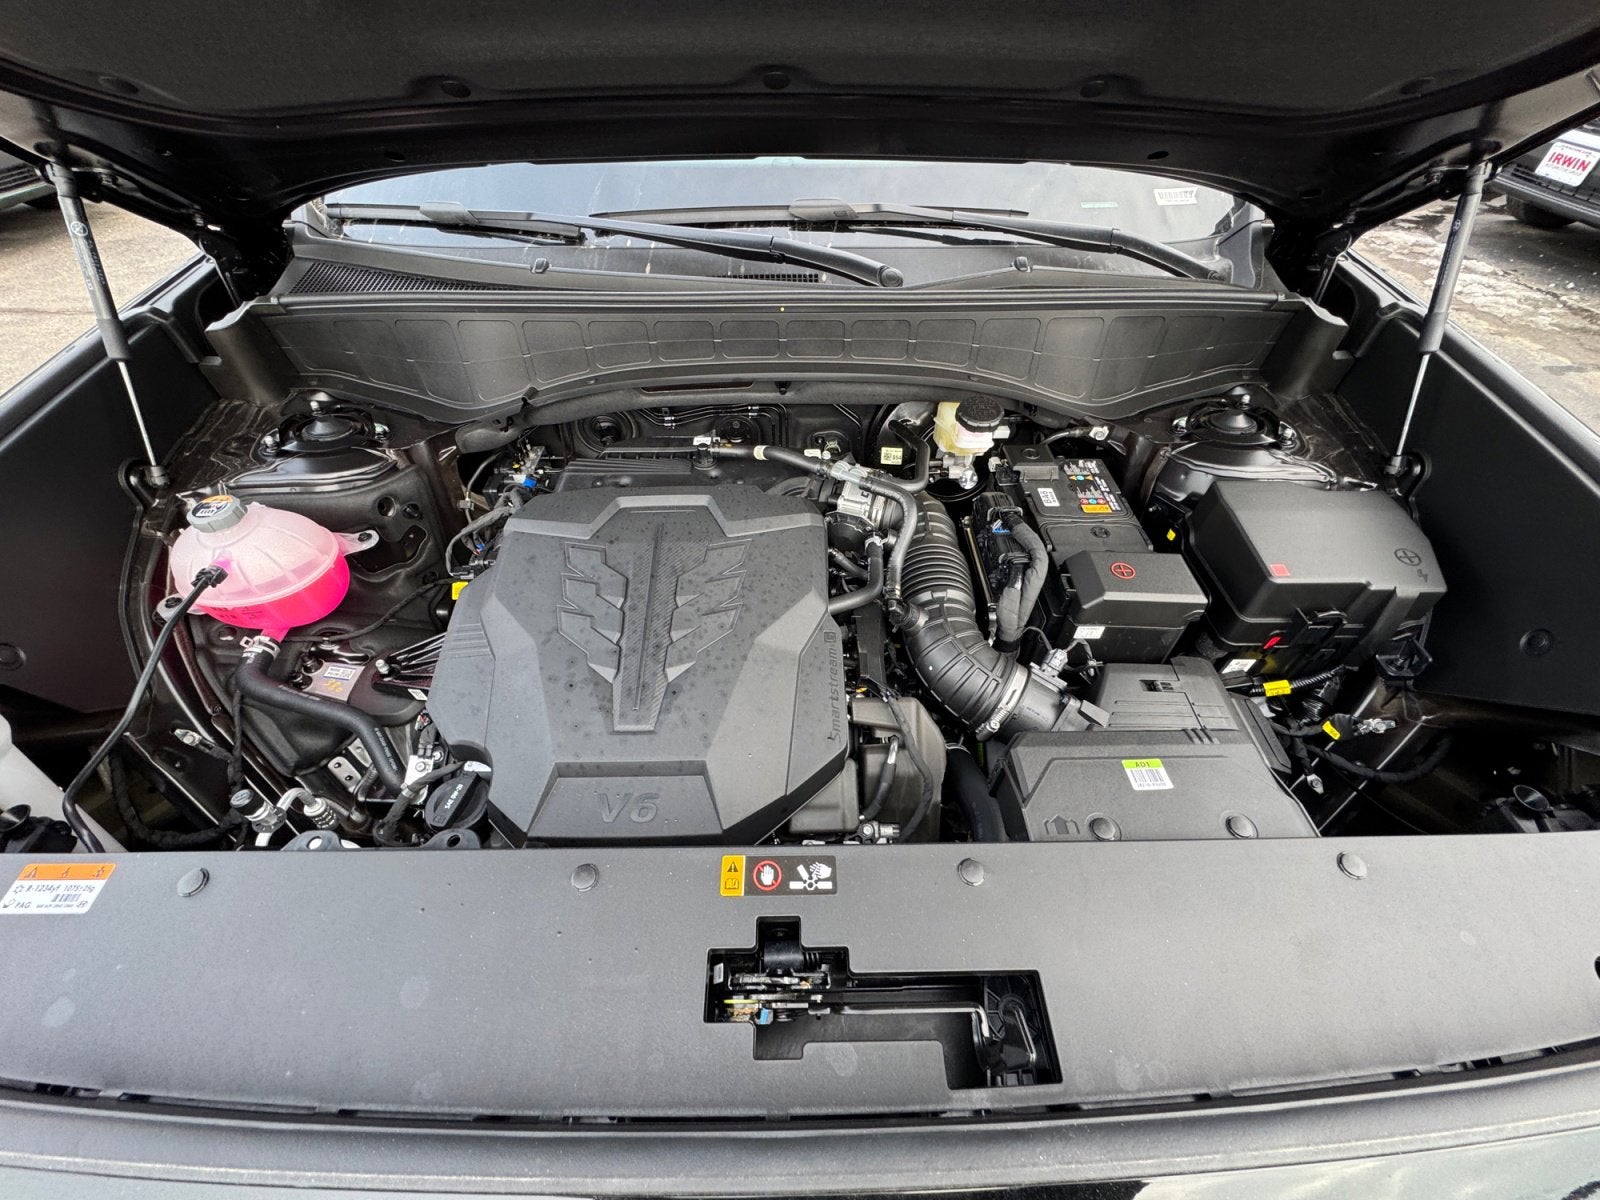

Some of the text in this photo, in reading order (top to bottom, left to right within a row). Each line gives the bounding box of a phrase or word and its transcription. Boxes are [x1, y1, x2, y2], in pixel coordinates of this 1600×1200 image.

[1548, 151, 1591, 172] IRWIN
[828, 647, 841, 741] Smartstream
[597, 792, 661, 824] V6
